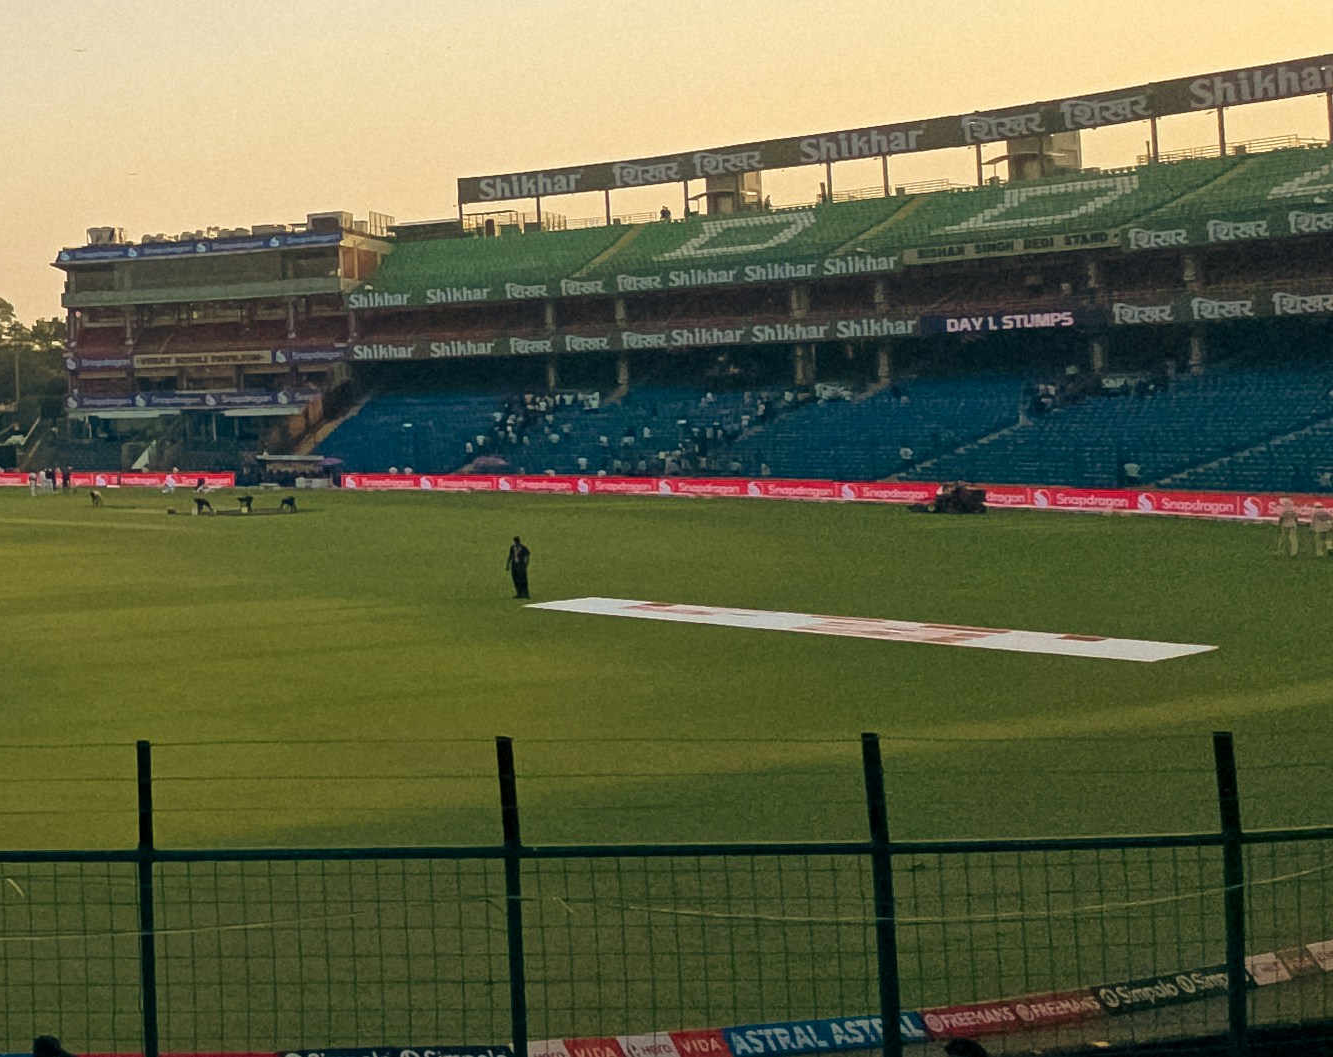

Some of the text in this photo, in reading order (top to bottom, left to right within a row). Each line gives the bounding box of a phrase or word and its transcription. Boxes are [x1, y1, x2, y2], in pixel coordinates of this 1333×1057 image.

[799, 128, 923, 163] Shikhar
[479, 171, 581, 200] Shikhar
[669, 256, 898, 287] Shikhar Shikhar Shikhar
[349, 287, 490, 309] Shikhar Shikhar
[836, 318, 917, 338] Shikhar
[946, 316, 983, 332] DAY
[1001, 312, 1074, 329] STUMPS
[671, 324, 829, 346] Shikhar Shikhar
[353, 342, 495, 360] Shikhar Shikhar
[863, 487, 928, 500] Snapdragon
[986, 491, 1025, 504] dragon
[1055, 494, 1129, 508] Snapdragon
[1162, 497, 1234, 514] Snapdragon
[1116, 980, 1180, 1004] Simpolo
[942, 1006, 1016, 1029] FREEMANS
[681, 1037, 723, 1053] VIDA
[731, 1025, 829, 1055] ASTRAL
